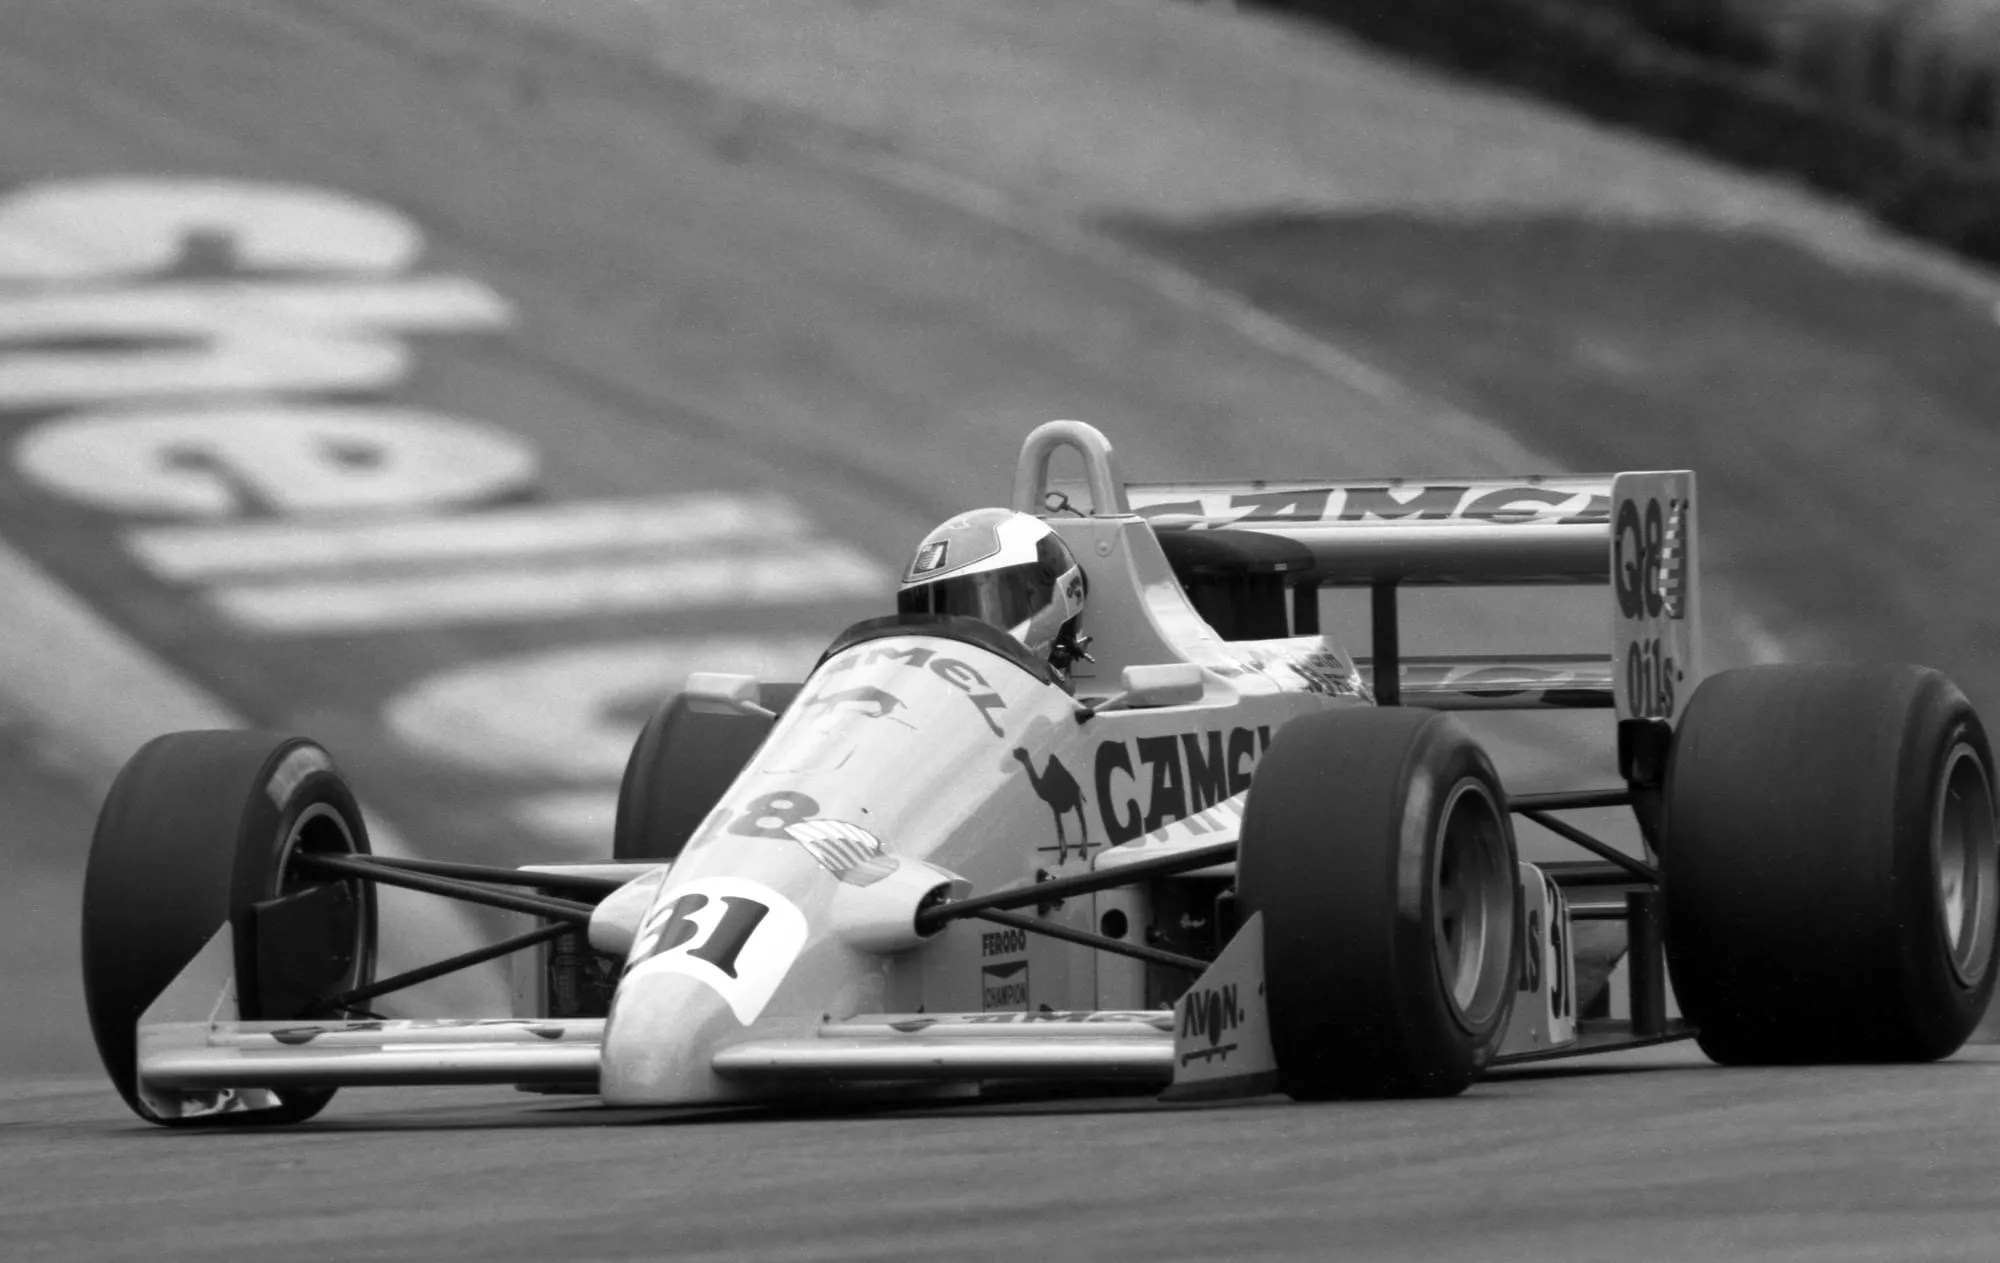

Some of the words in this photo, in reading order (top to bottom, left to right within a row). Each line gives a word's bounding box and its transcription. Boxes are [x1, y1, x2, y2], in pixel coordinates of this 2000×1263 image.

[1615, 497, 1662, 621] Q8
[624, 892, 770, 980] 31
[982, 929, 1027, 957] FERODO
[986, 982, 1027, 1009] CHAMPION
[1182, 983, 1238, 1047] AVON
